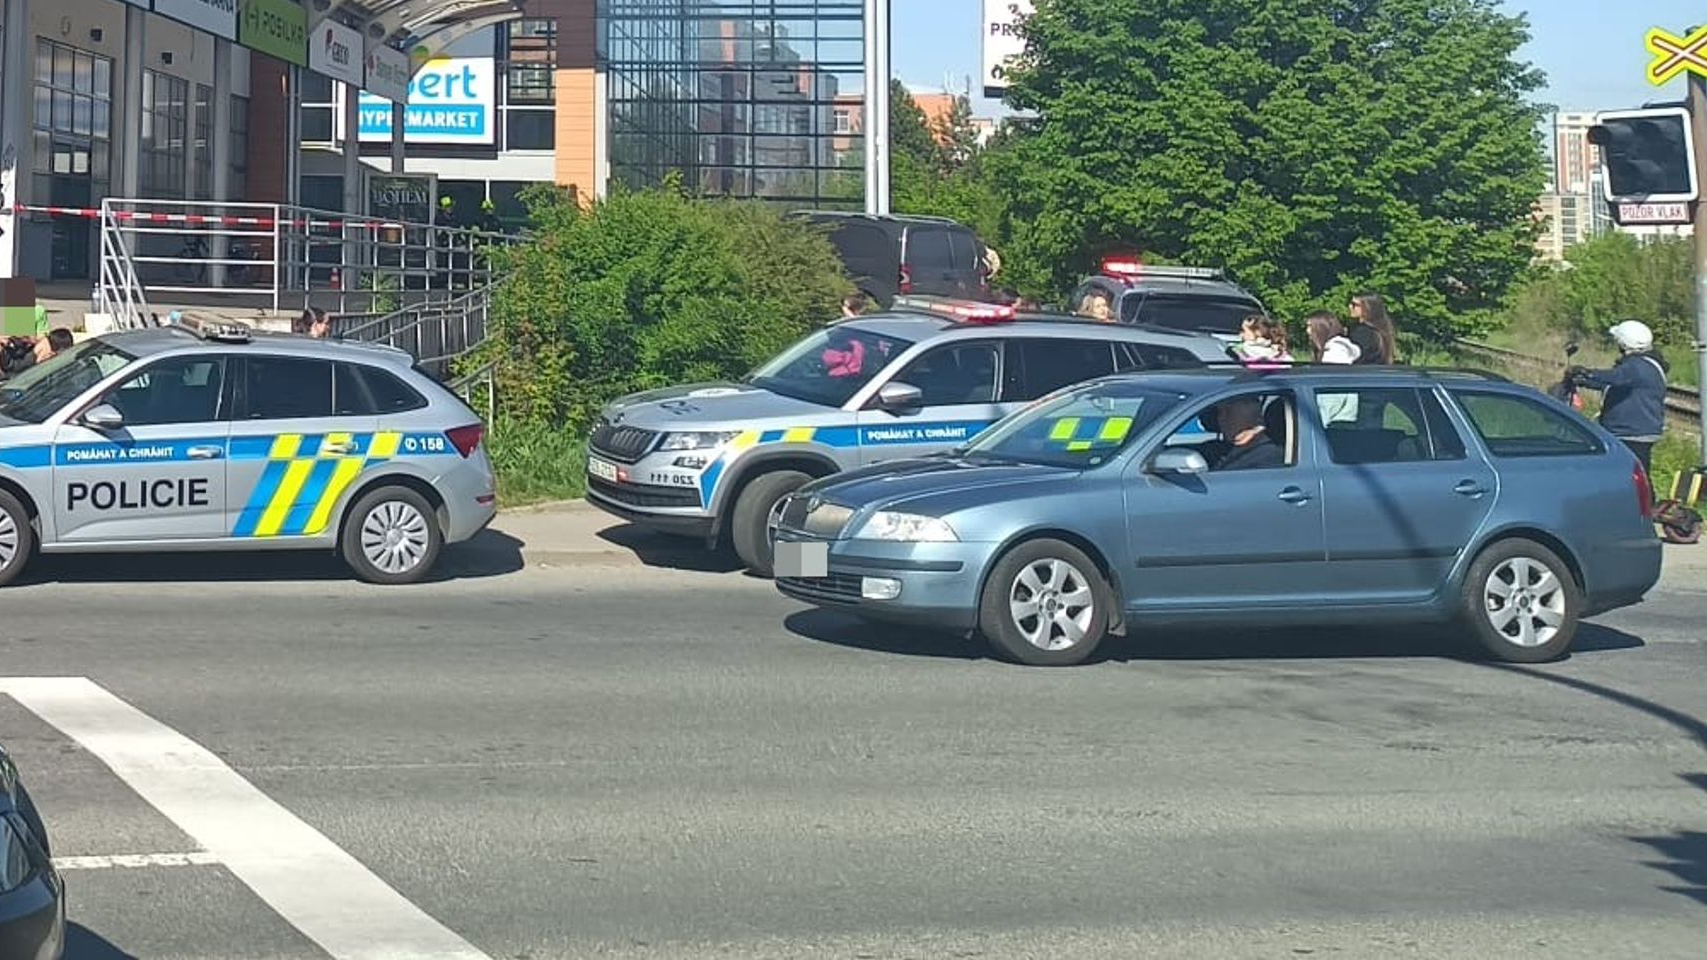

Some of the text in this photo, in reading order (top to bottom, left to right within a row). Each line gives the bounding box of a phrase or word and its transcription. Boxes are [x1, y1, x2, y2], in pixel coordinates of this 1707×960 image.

[359, 107, 479, 129] YPMARKET
[419, 437, 445, 451] 158
[67, 447, 116, 461] POMÁHAT
[119, 450, 127, 458] A
[67, 477, 209, 512] POLICIE
